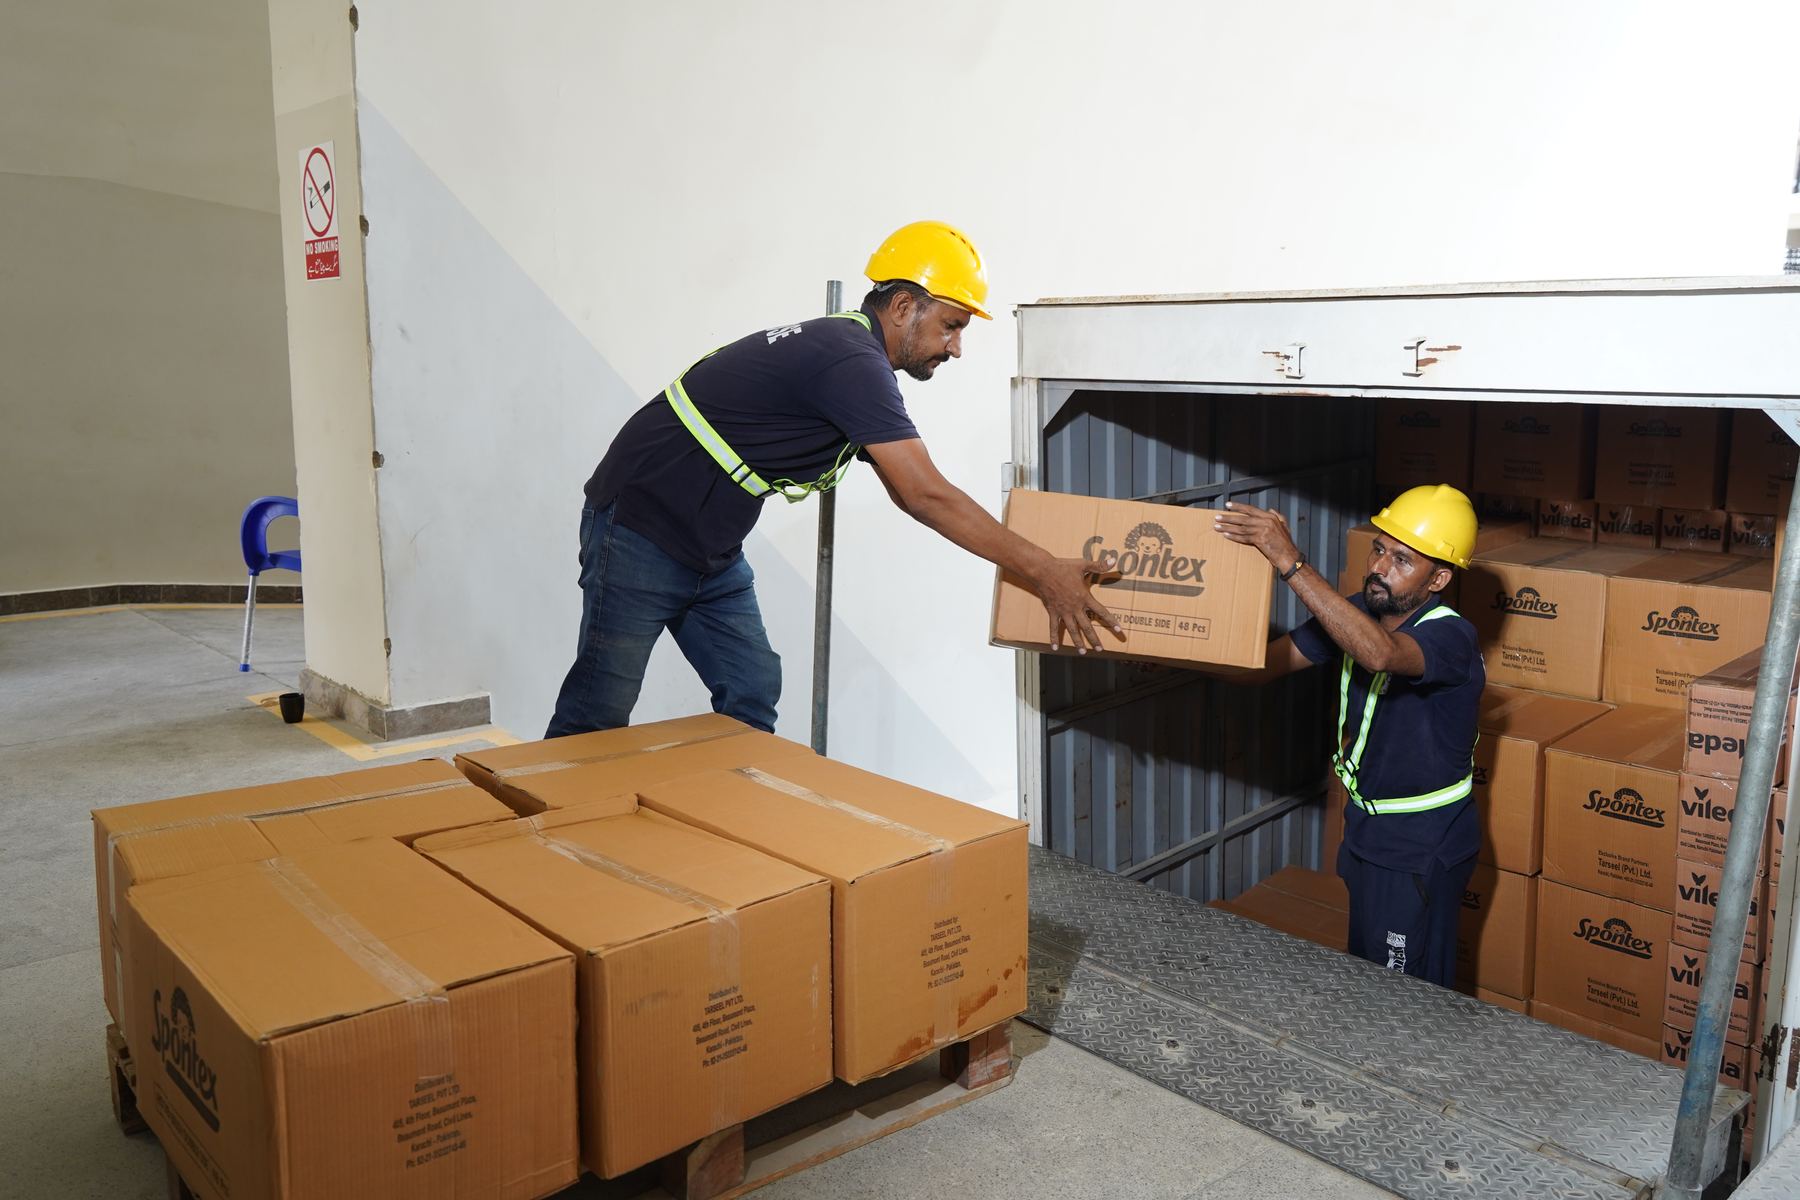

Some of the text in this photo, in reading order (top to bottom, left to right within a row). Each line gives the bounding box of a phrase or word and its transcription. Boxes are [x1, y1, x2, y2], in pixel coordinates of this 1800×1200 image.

[305, 239, 338, 255] NO SMOKING
[1541, 513, 1592, 529] vileda
[1600, 520, 1654, 536] vileda
[1664, 523, 1721, 540] vileda
[1490, 591, 1558, 614] Spontex
[1124, 614, 1153, 627] DOUBLE
[1154, 618, 1171, 629] SIDE
[1178, 620, 1206, 633] 48 Pcs
[1641, 611, 1720, 635] Spontex
[1688, 732, 1745, 759] leda
[1582, 789, 1666, 822] Spontex
[1681, 799, 1735, 823] vile
[1598, 857, 1620, 871] Tarseel
[1573, 918, 1653, 953] Spontex
[152, 989, 219, 1113] Spontex
